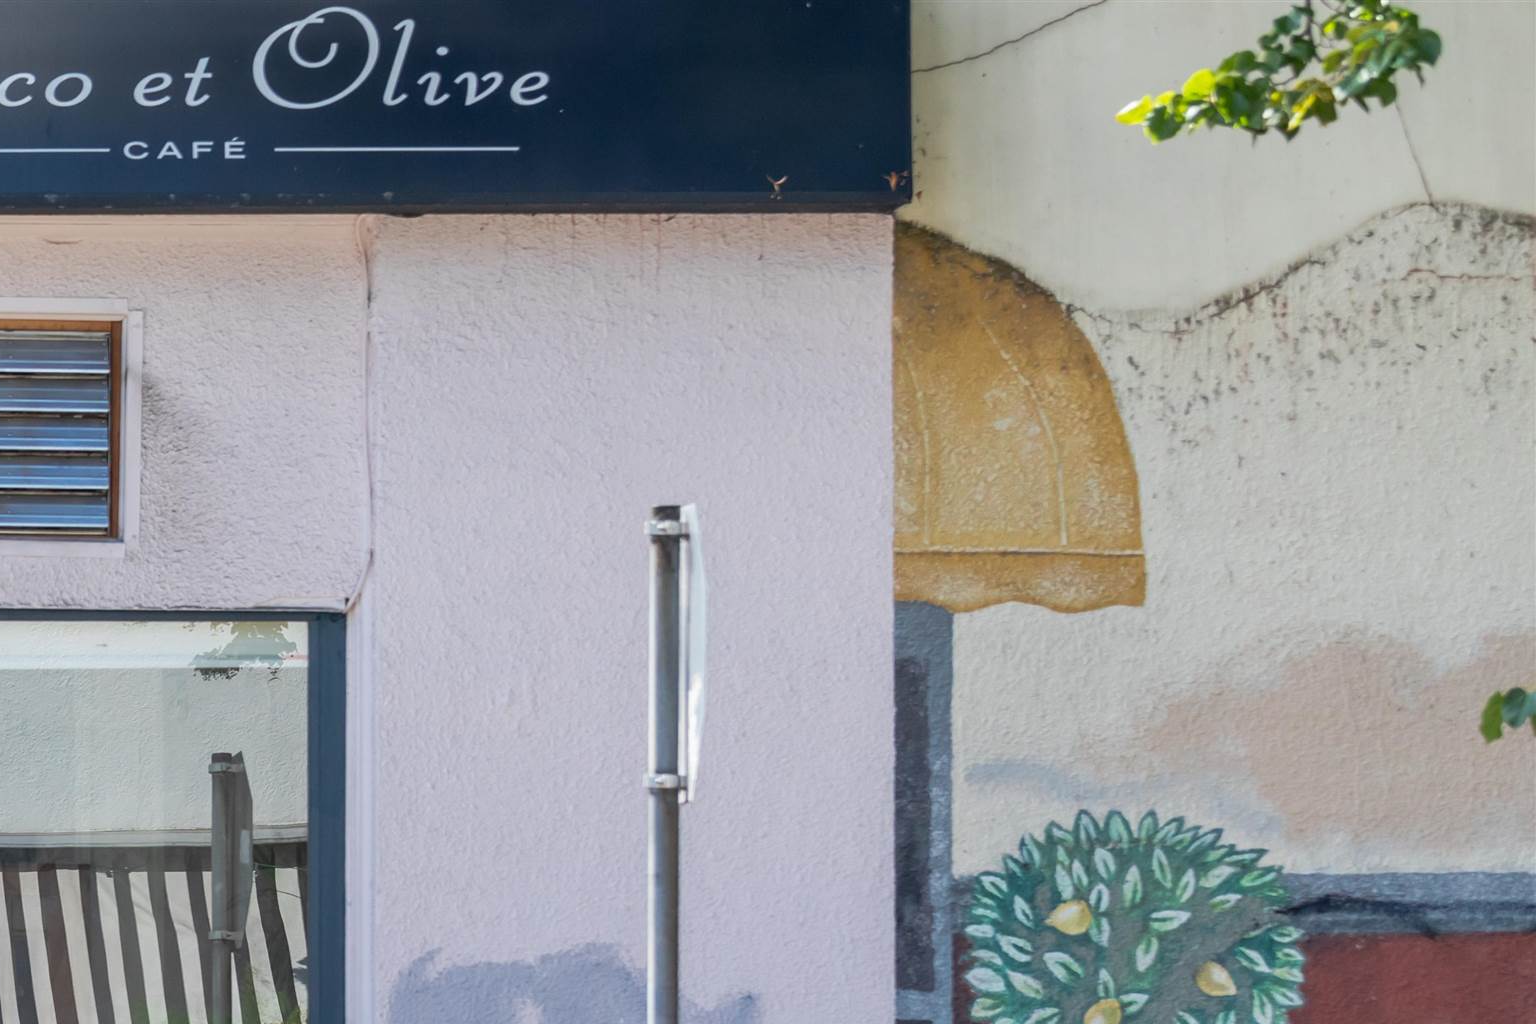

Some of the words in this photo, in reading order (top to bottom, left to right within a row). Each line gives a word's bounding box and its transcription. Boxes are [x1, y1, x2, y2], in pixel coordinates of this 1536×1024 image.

[132, 56, 213, 108] et
[252, 6, 550, 110] Olive
[123, 137, 246, 160] CAFÉ
